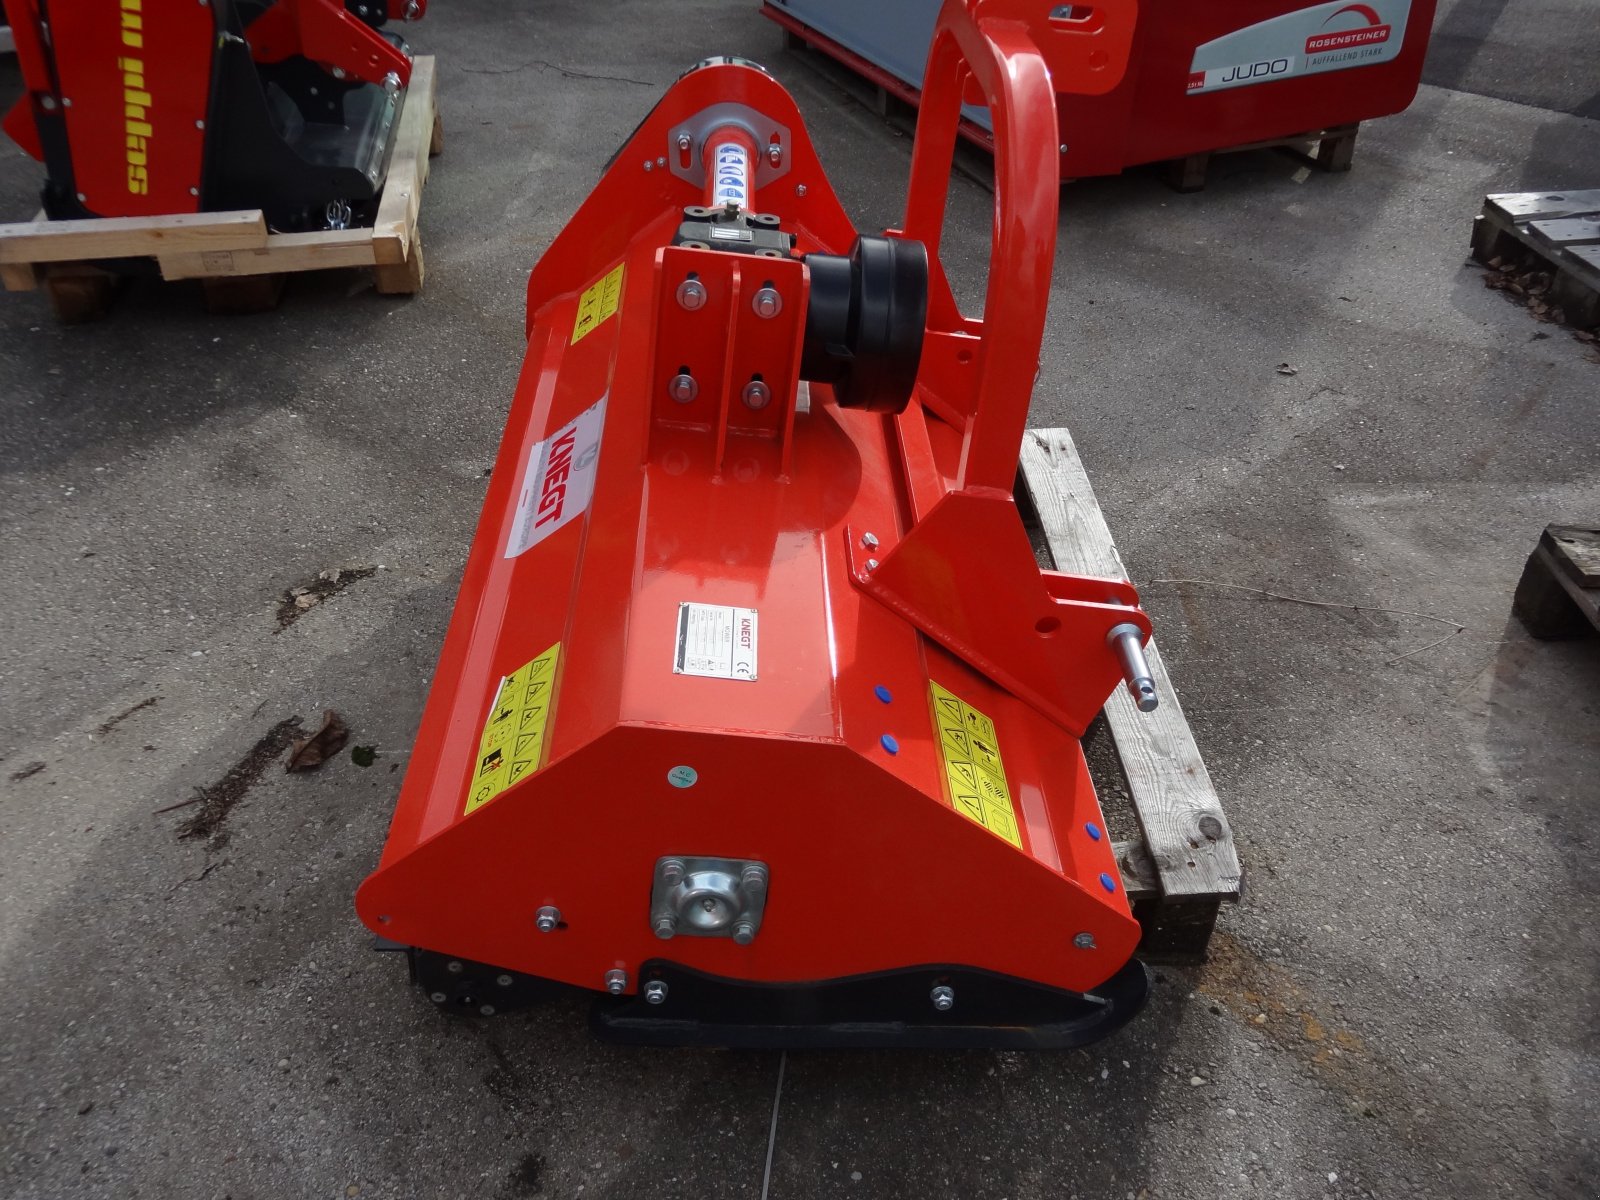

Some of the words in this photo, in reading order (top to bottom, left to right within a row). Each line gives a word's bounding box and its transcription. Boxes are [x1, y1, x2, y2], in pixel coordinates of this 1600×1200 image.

[1308, 29, 1387, 48] ROSENSTEINER
[1311, 52, 1358, 65] AUFFALLEND
[1360, 47, 1383, 58] STARK
[1222, 59, 1288, 82] JUDO
[118, 56, 153, 195] seppi
[535, 426, 577, 529] KNEGT
[741, 618, 751, 649] KNEGT
